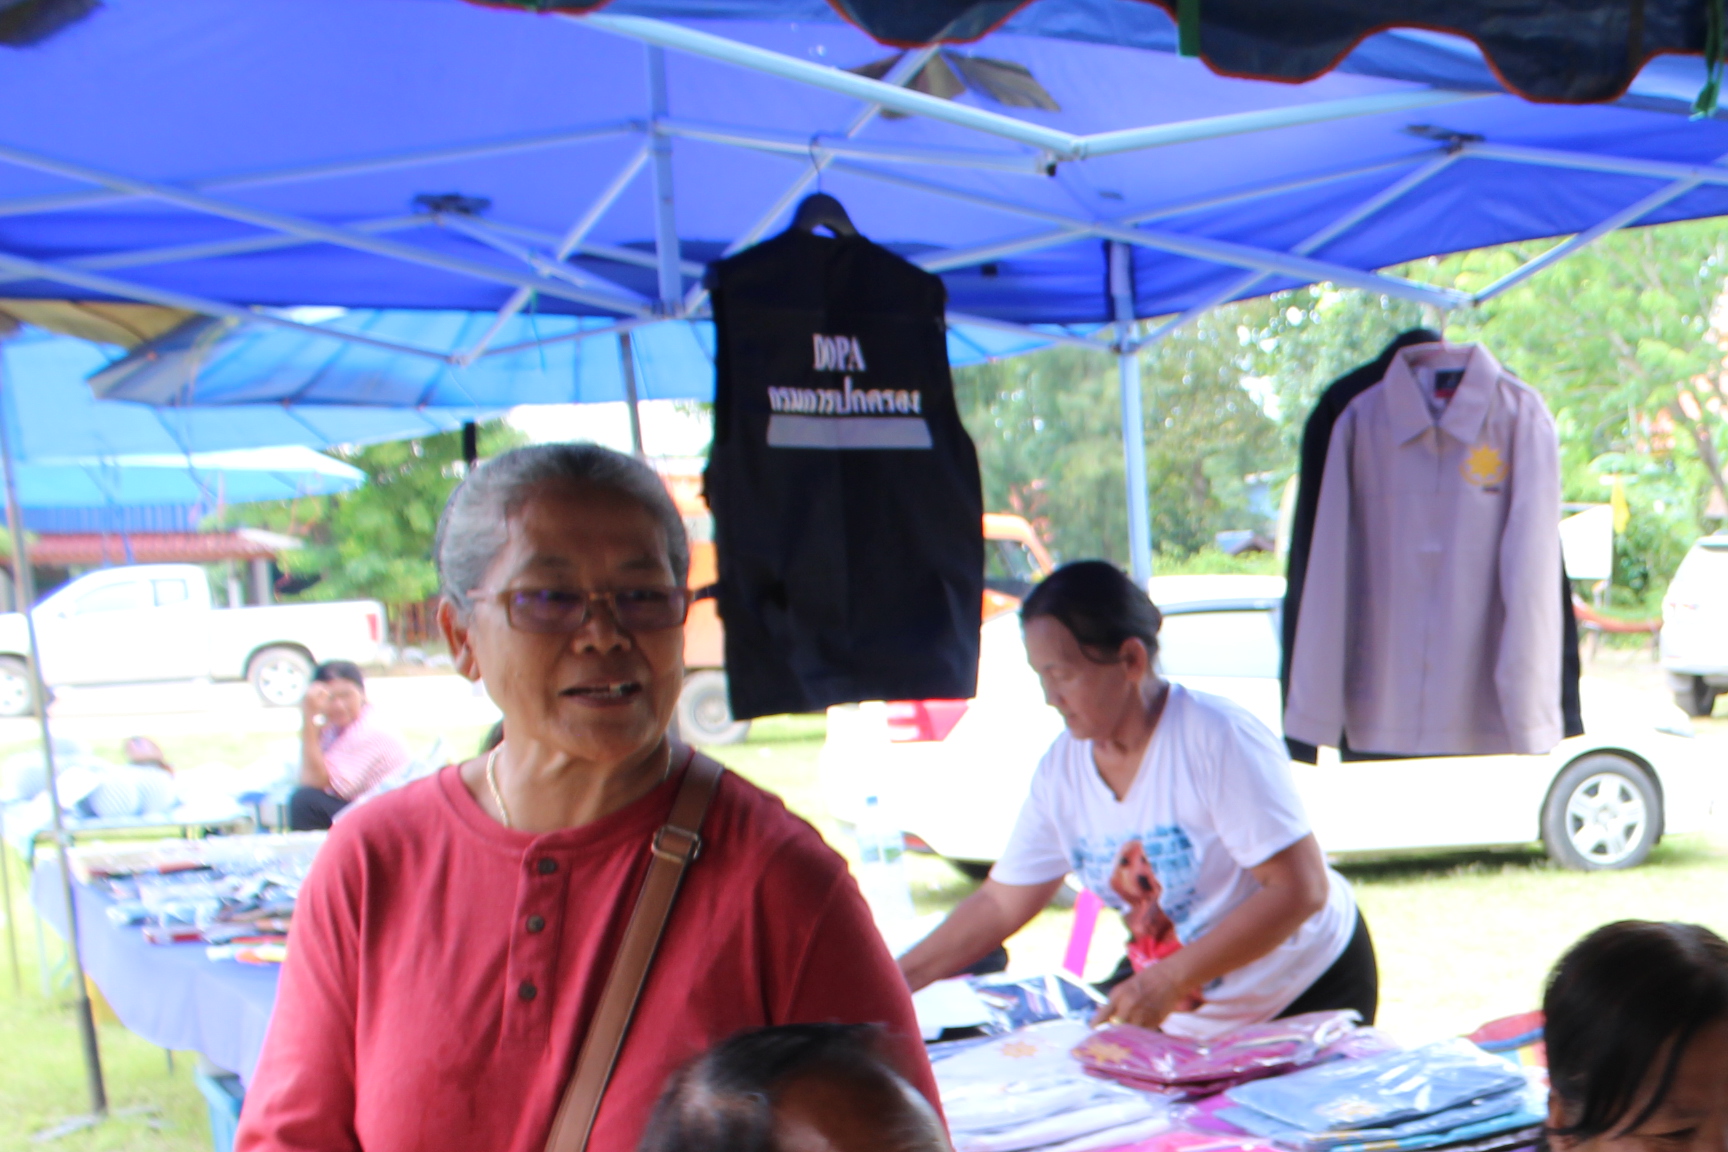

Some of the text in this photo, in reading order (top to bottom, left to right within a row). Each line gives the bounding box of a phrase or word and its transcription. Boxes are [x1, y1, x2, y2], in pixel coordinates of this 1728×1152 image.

[812, 333, 866, 371] DOPA
[768, 375, 922, 414] กรมการปกครอง
